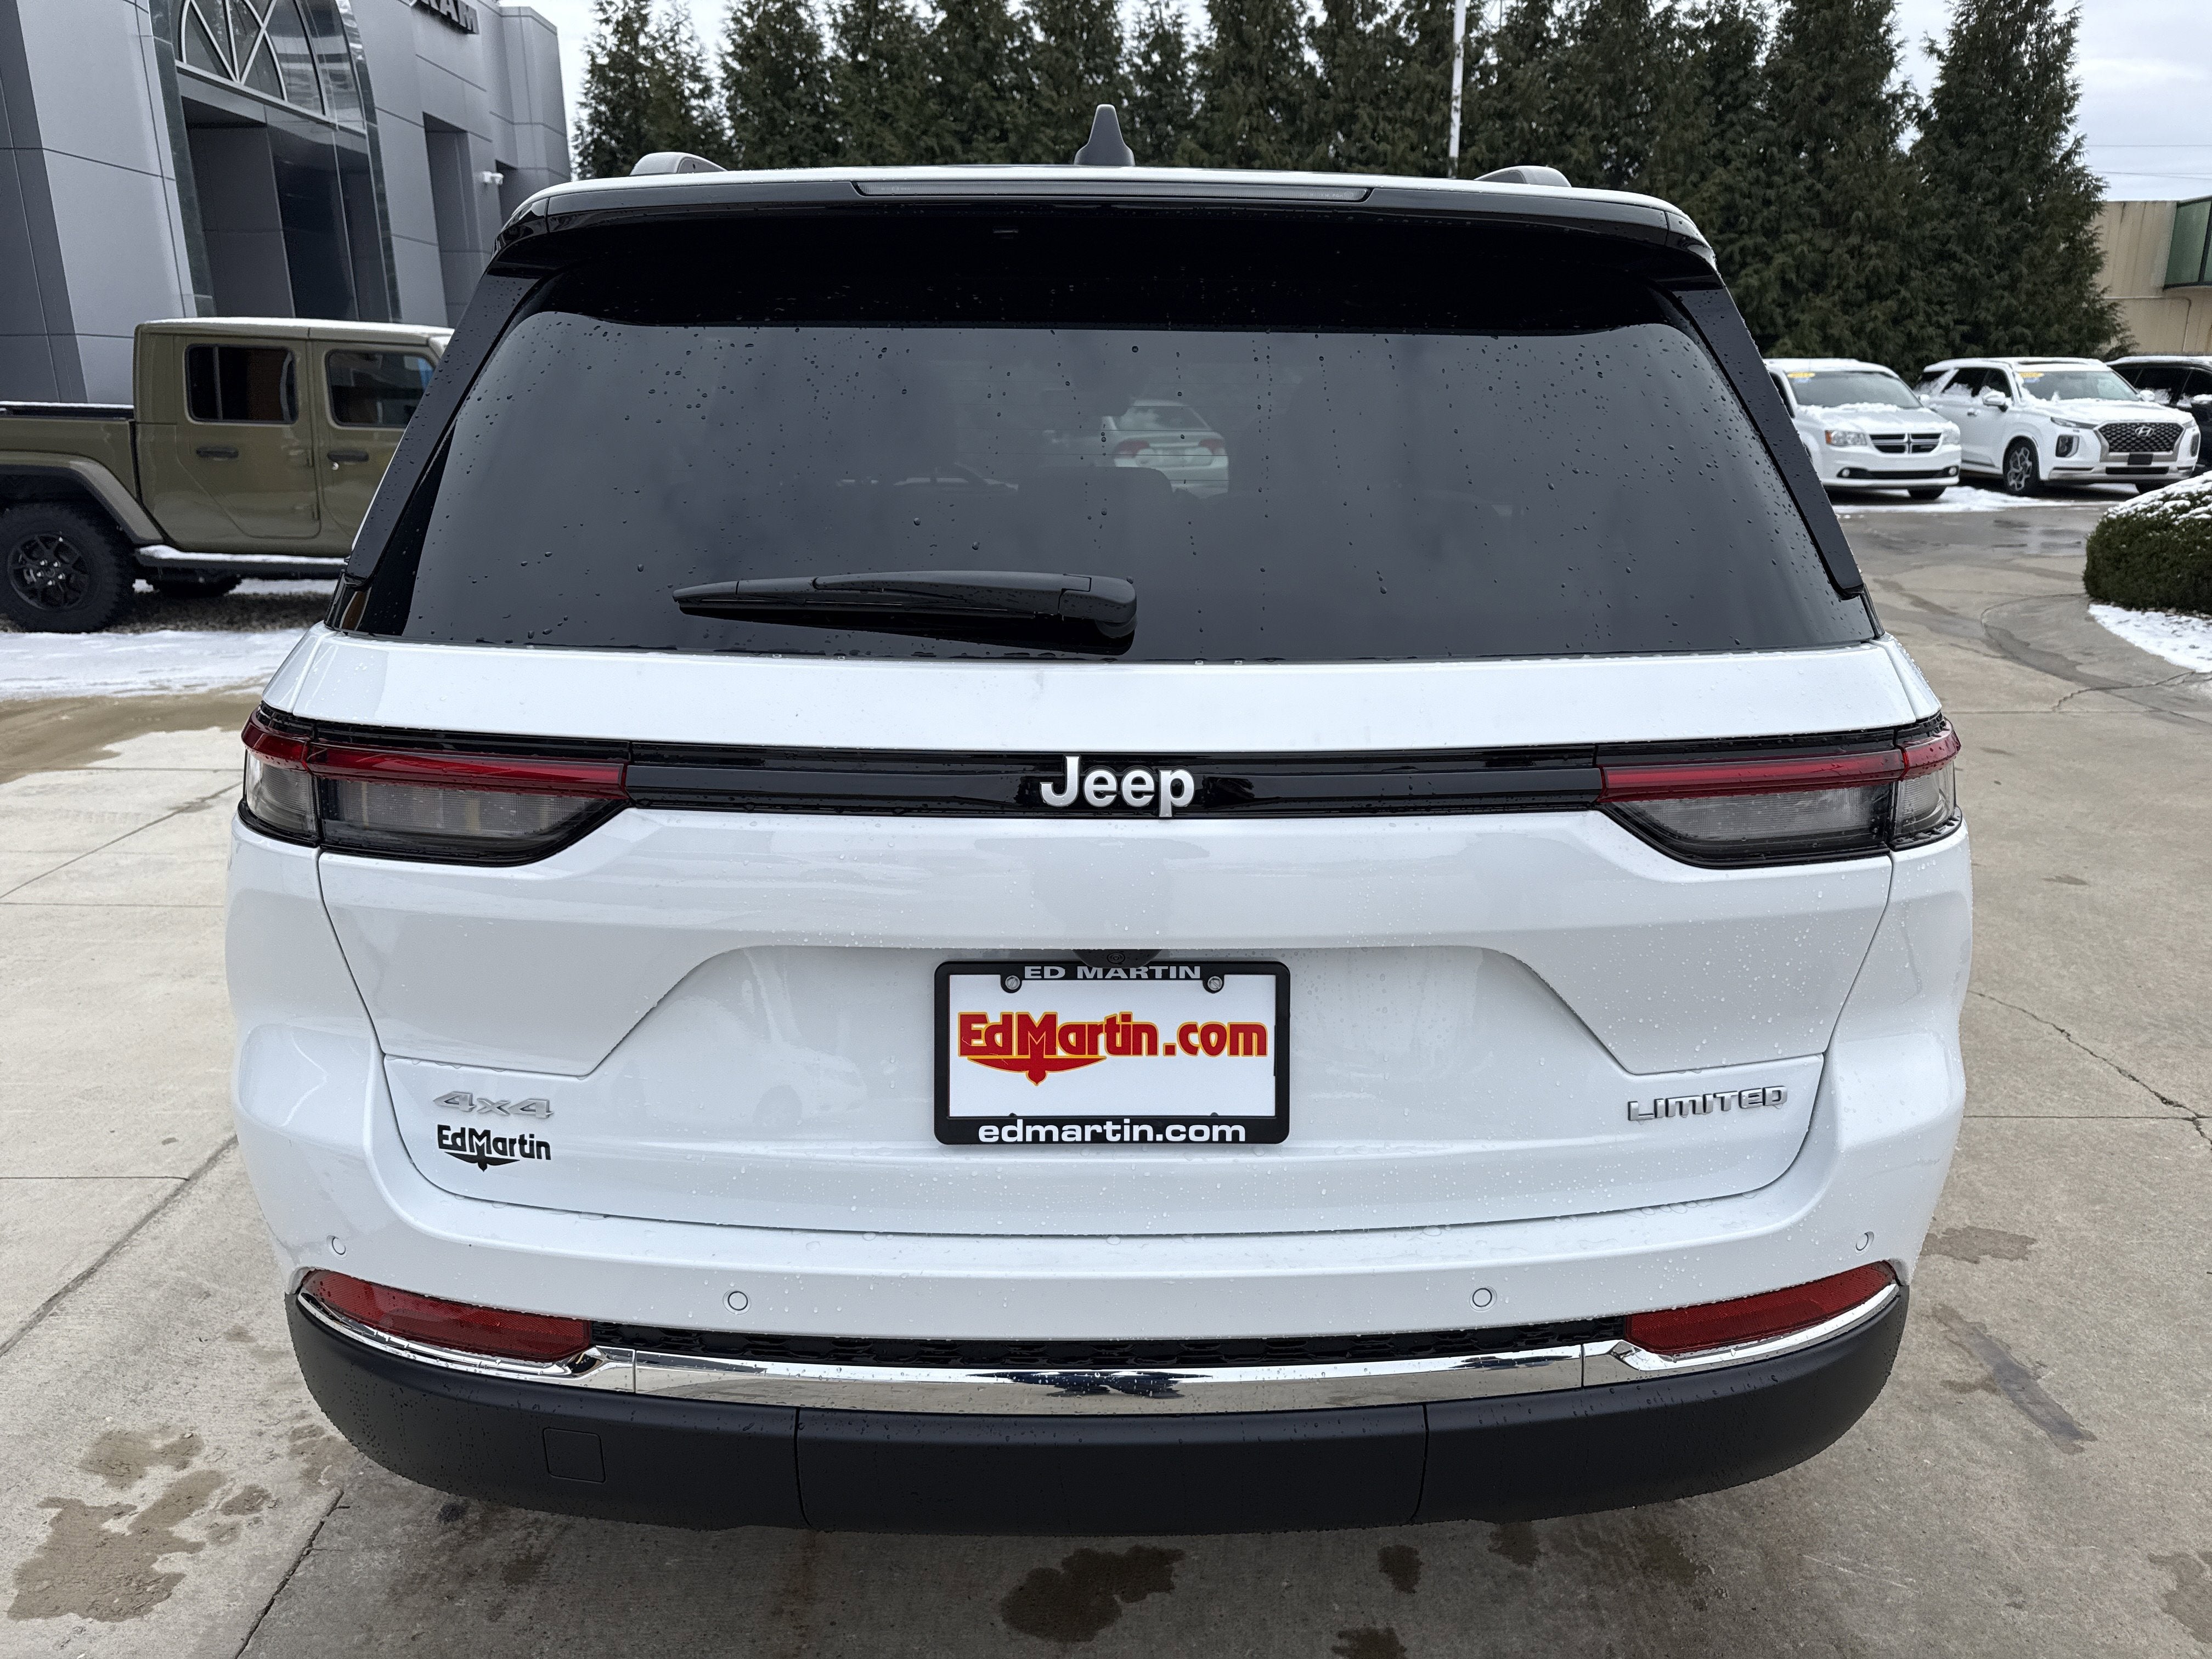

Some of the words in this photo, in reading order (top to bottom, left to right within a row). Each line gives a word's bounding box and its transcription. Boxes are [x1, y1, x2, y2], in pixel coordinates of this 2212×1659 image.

[1040, 755, 1194, 817] Jeep
[1024, 966, 1065, 979] ED
[1076, 966, 1200, 979] MARTIN
[957, 1012, 1268, 1057] EdMartin.com
[432, 1091, 554, 1118] 4x4
[1628, 1086, 1787, 1121] LIMITED
[437, 1124, 551, 1160] EdMartin
[978, 1119, 1245, 1142] edmartin.com
